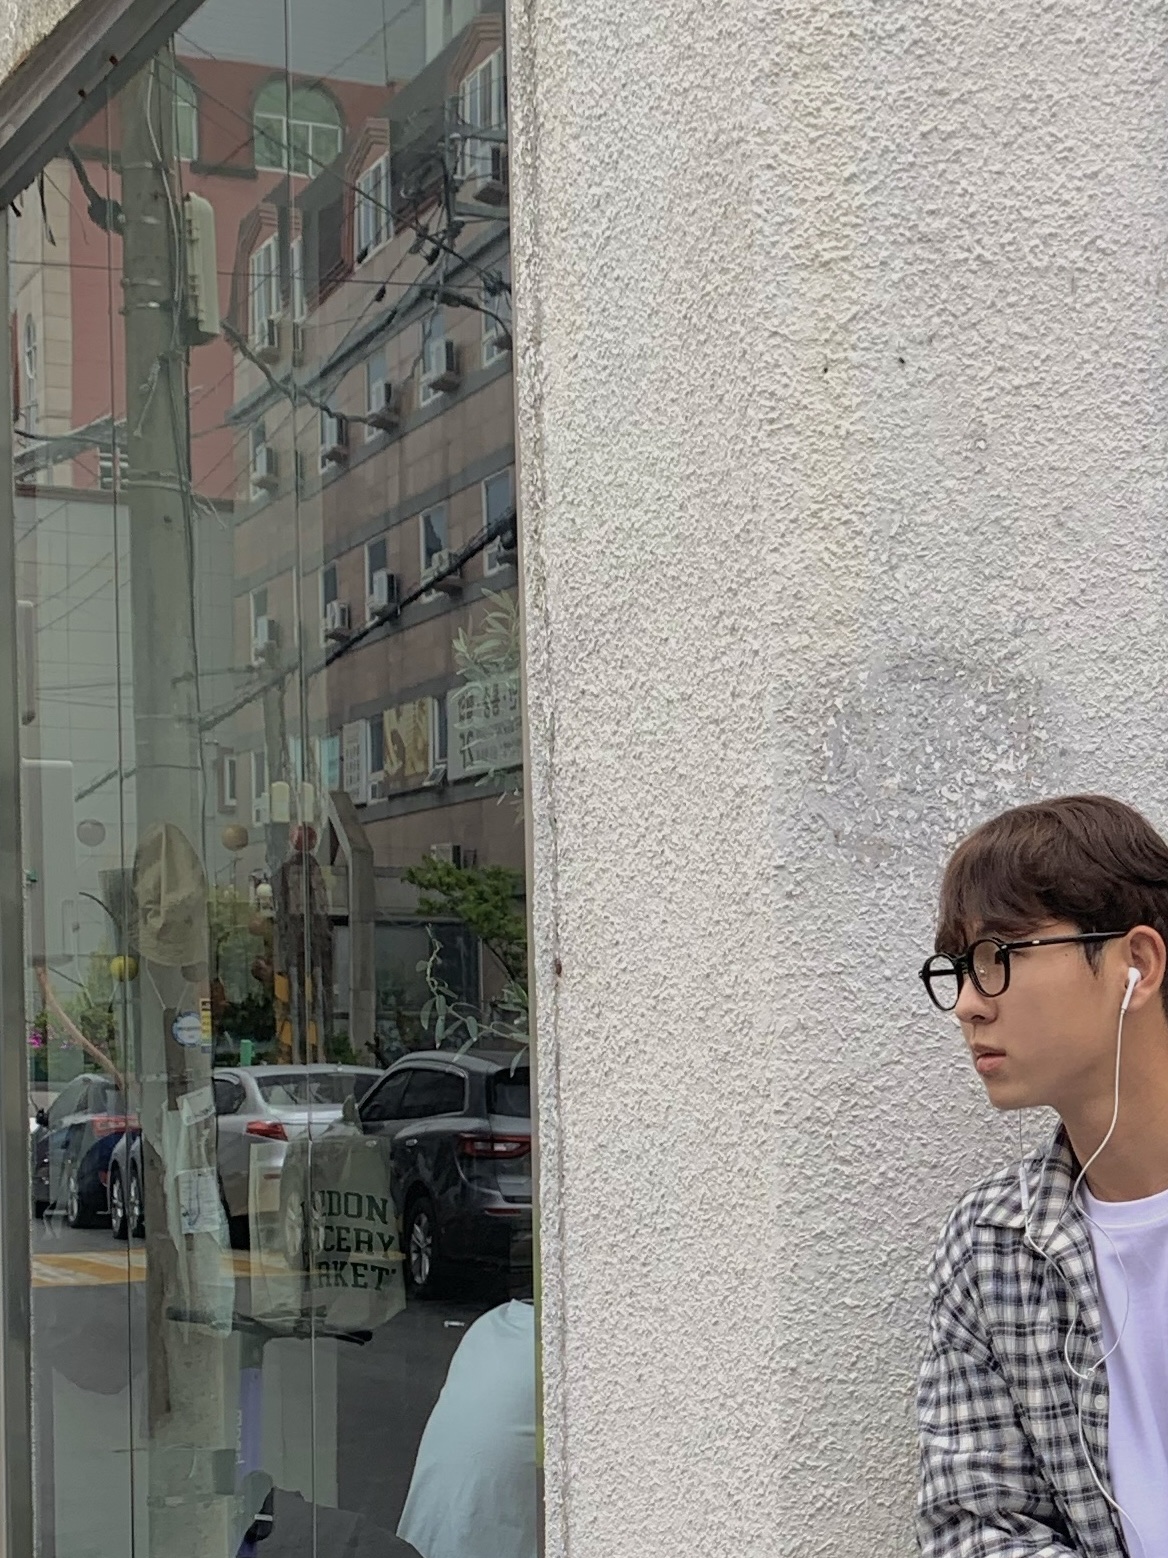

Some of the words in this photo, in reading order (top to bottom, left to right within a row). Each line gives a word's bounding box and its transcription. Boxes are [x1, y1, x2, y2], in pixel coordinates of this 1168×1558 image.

[310, 1189, 389, 1225] NDON
[322, 1225, 395, 1259] CERY
[316, 1260, 391, 1292] RKET
